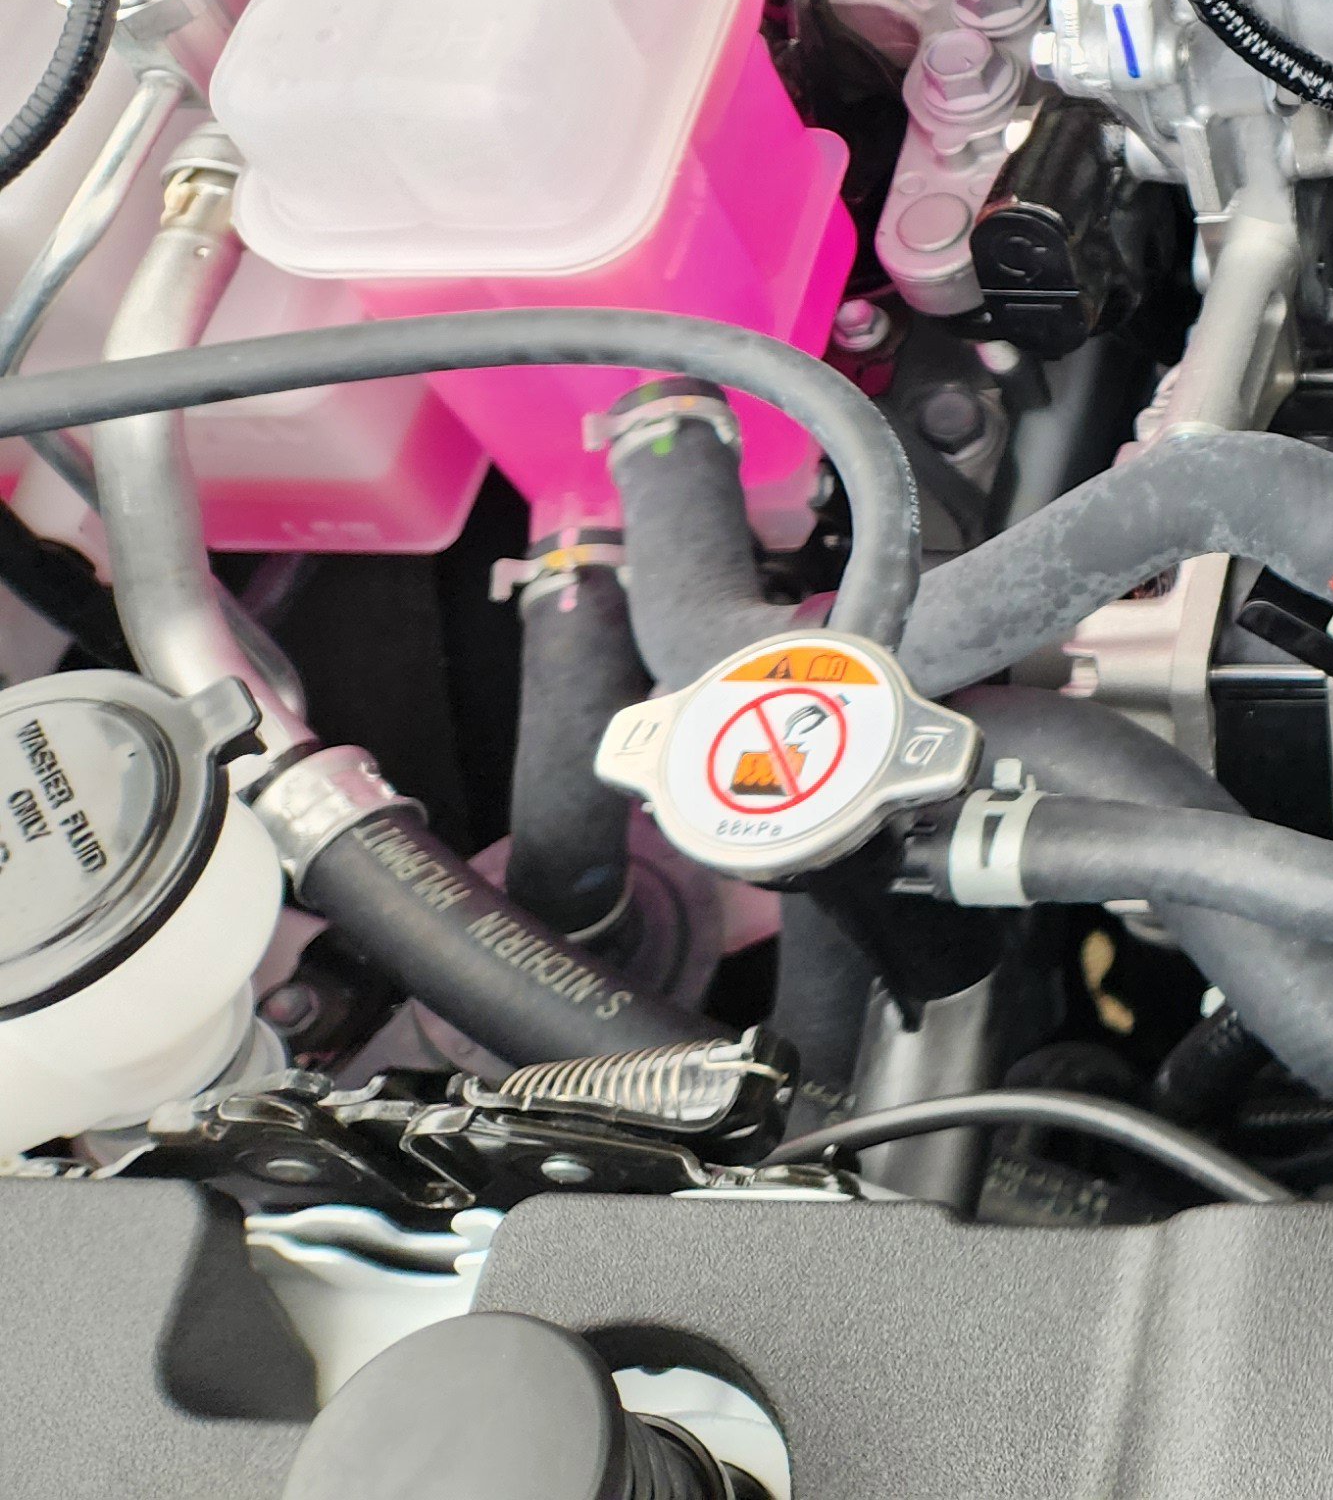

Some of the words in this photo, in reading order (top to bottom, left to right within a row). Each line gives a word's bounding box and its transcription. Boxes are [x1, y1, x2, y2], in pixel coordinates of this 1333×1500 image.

[7, 788, 52, 843] ONLY
[16, 718, 75, 810] WASHER
[59, 809, 108, 874] FLUID
[716, 819, 784, 838] 88kPa
